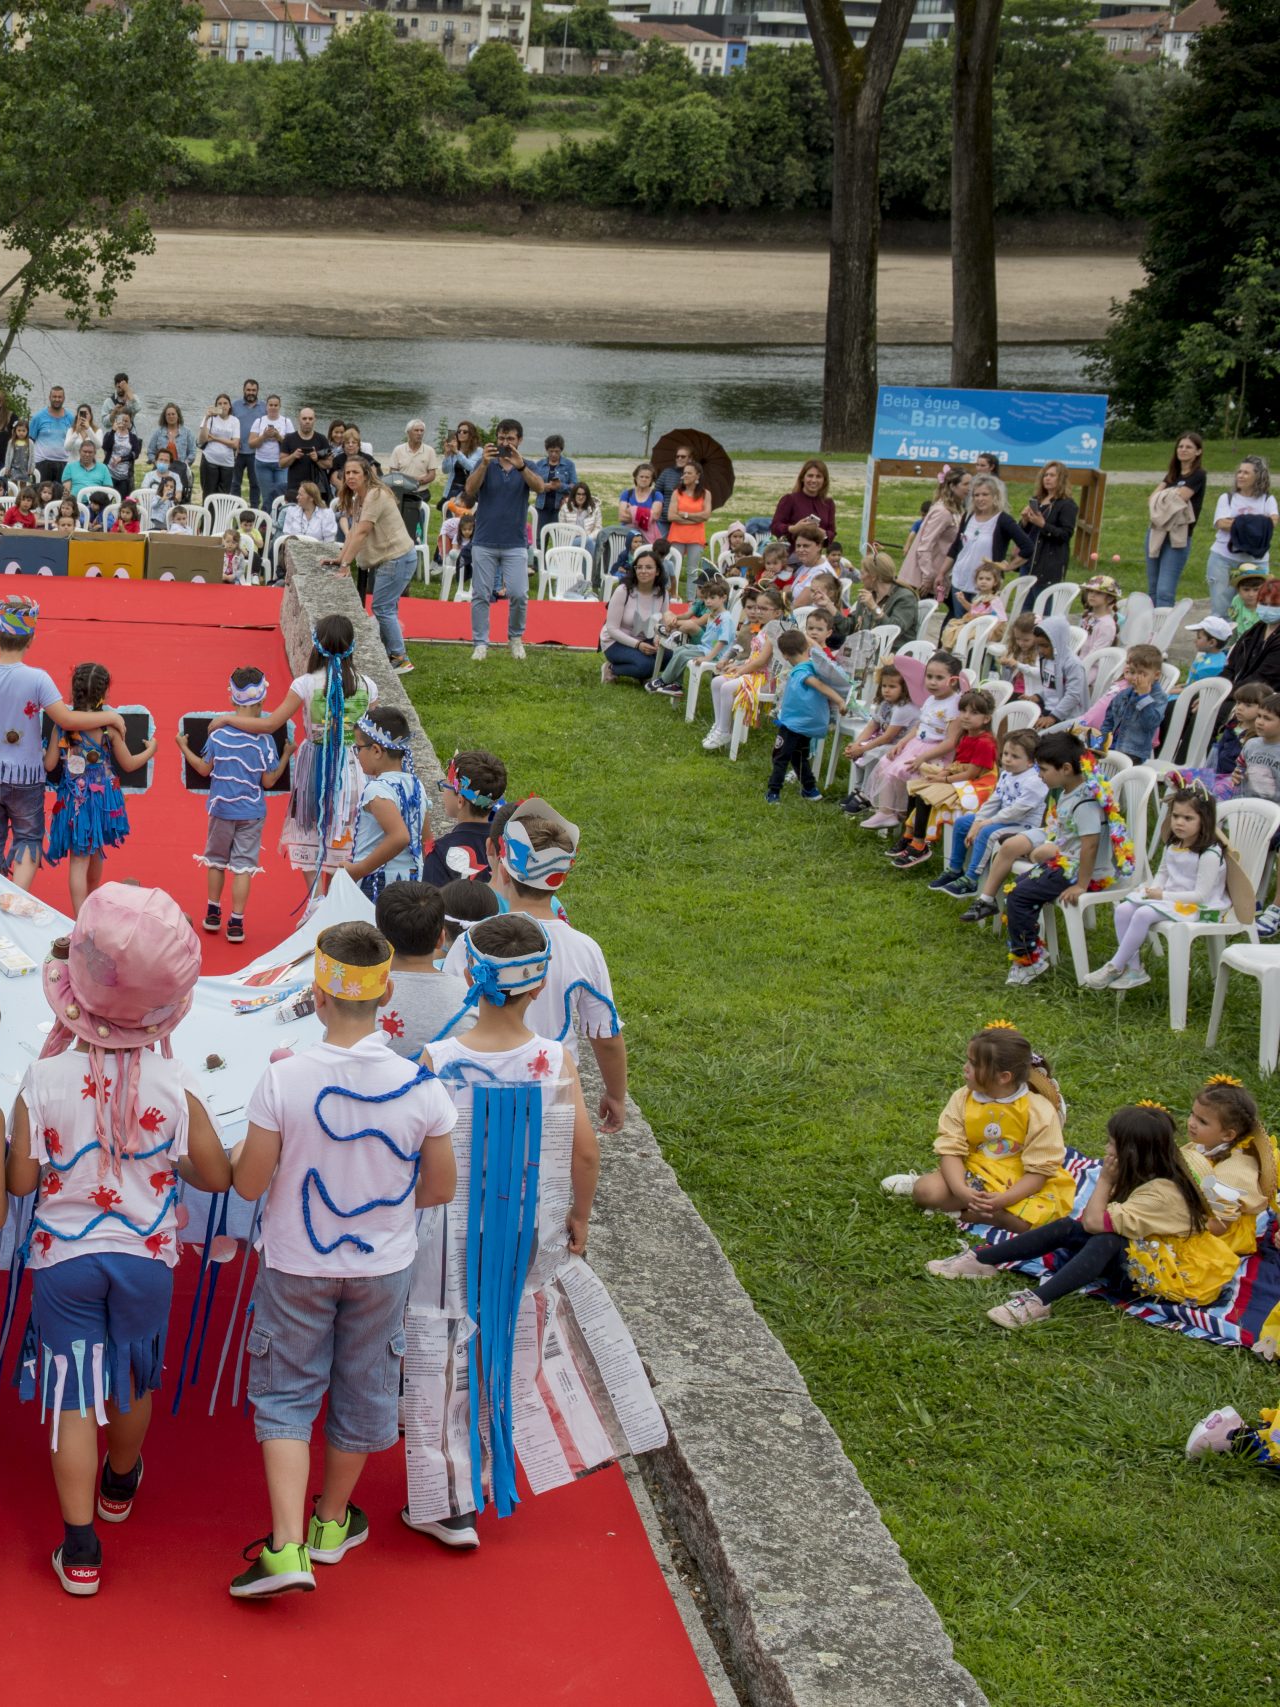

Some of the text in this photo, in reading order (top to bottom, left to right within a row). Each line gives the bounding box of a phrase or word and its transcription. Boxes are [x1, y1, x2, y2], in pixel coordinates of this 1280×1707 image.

[882, 393, 960, 412] Beba água
[897, 412, 908, 421] de
[910, 410, 1001, 431] Barcelos
[896, 437, 939, 460] Água
[948, 445, 1008, 463] Segra
[71, 1569, 98, 1578] adidas
